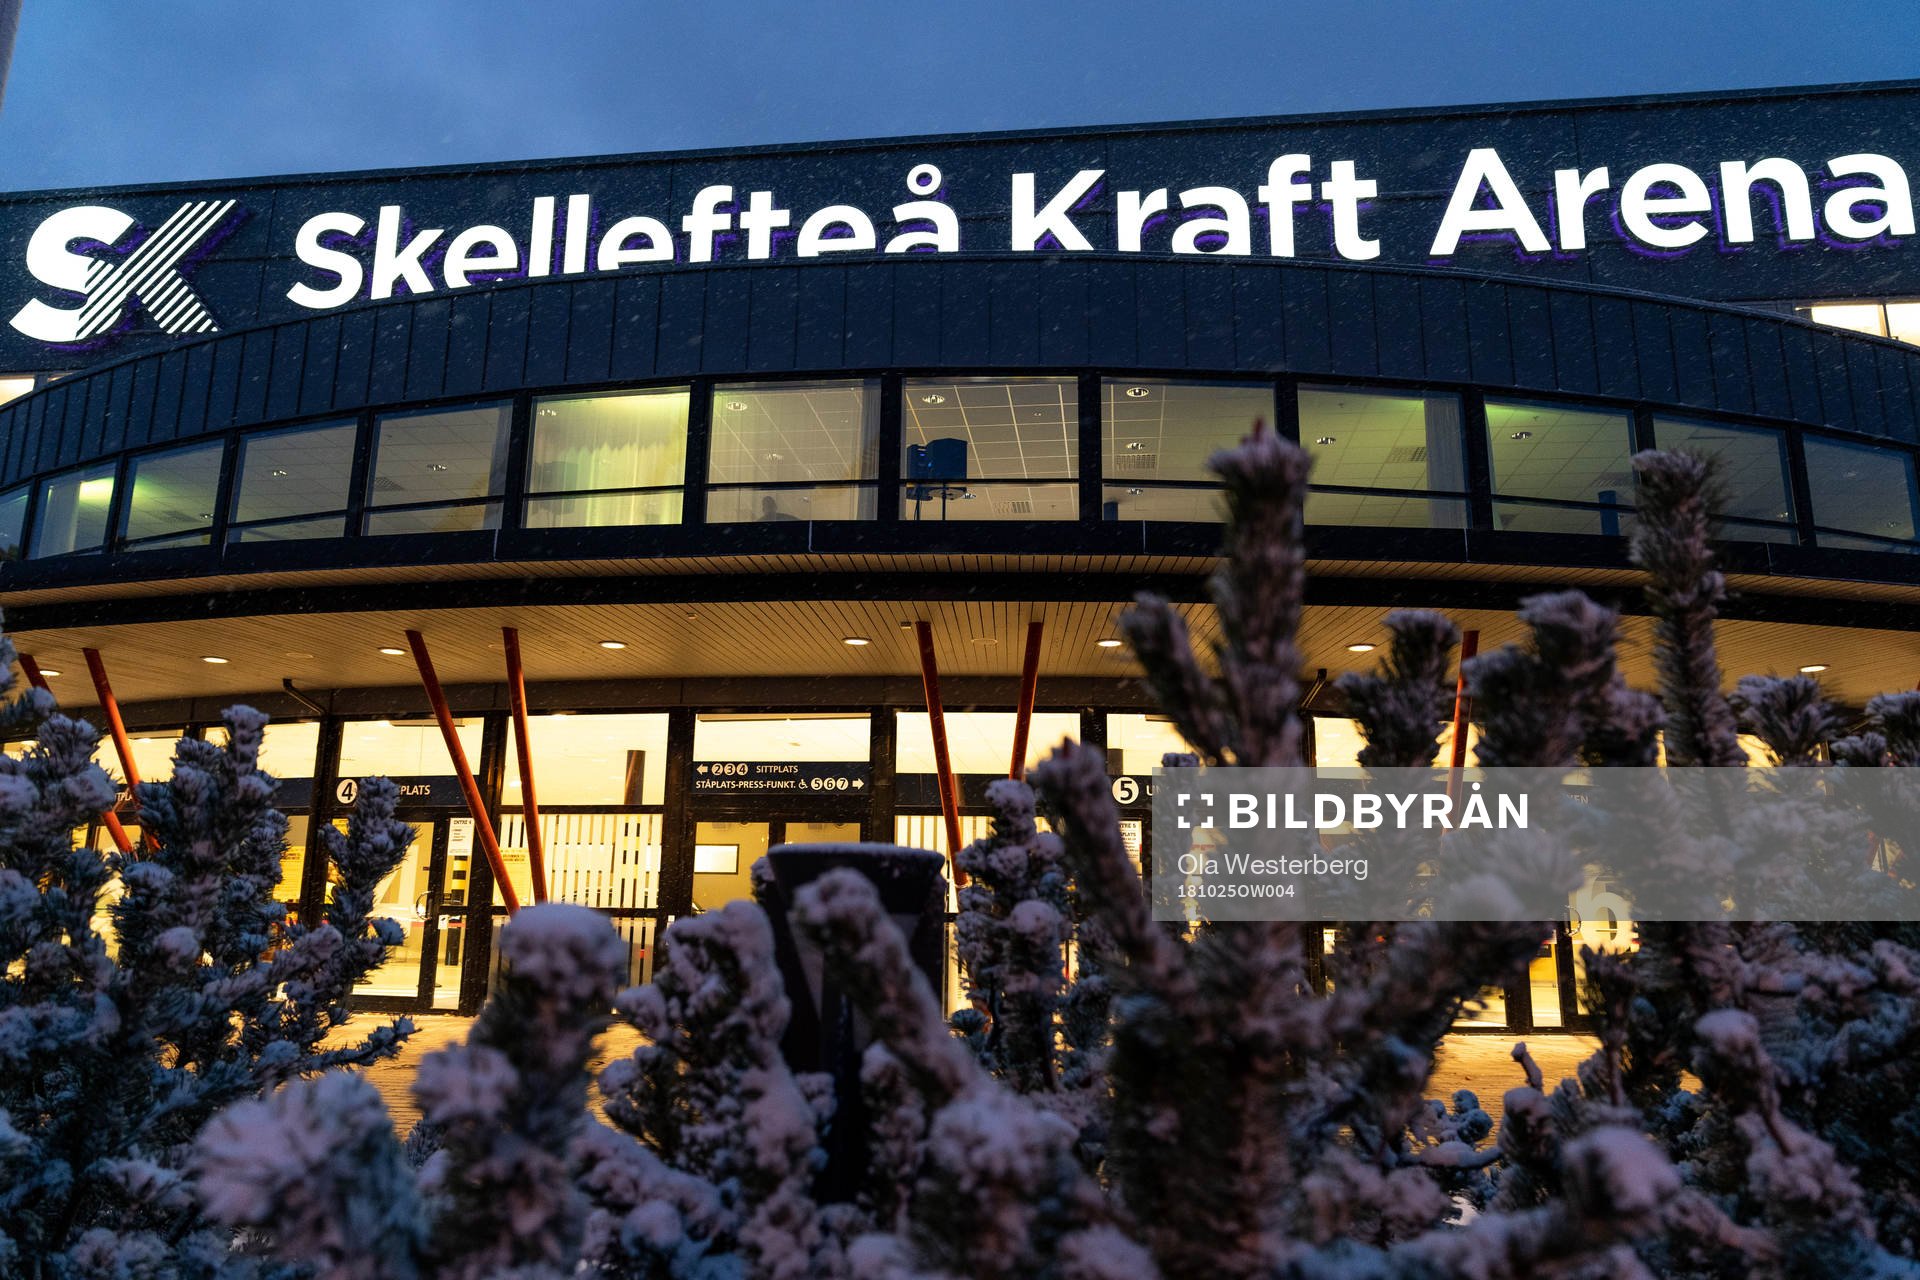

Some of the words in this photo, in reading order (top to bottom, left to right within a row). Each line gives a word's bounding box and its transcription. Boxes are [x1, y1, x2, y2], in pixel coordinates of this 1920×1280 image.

[286, 164, 960, 310] Skellefteå
[1012, 153, 1382, 261] Kraft
[1430, 147, 1917, 256] Arena
[10, 199, 237, 343] SK
[756, 765, 799, 773] SITTPLATS
[340, 781, 356, 802] 4
[695, 779, 796, 789] STÅPLATS-PRESS-FUNKT.
[1118, 780, 1135, 801] 5
